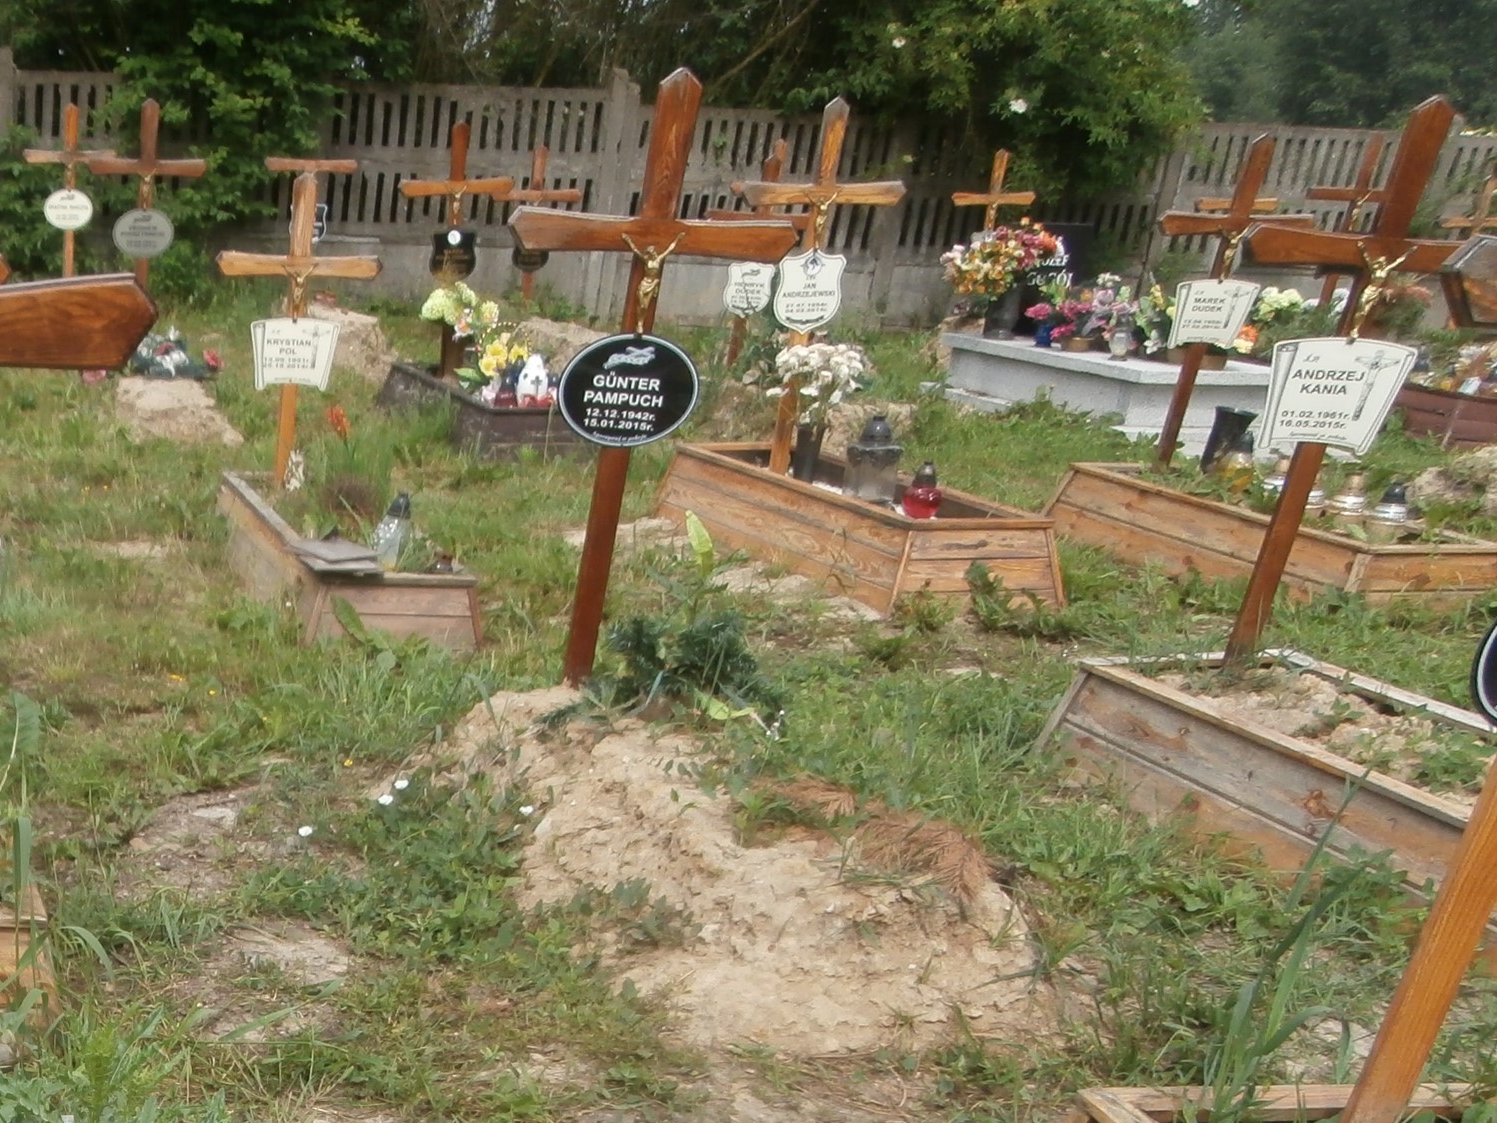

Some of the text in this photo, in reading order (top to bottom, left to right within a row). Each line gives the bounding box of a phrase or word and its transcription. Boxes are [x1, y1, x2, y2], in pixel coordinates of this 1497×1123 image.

[1194, 297, 1226, 305] MAREK
[1192, 305, 1223, 313] DUDEK
[266, 338, 311, 347] KRYSTIAN
[593, 371, 660, 391] GÜNTER
[1292, 369, 1365, 381] ANDRZEJ
[1300, 383, 1347, 395] KANIA
[583, 390, 663, 407] PAMPUCH
[585, 408, 656, 421] 12.12.1942r.
[583, 418, 654, 431] 15.01.2015r.
